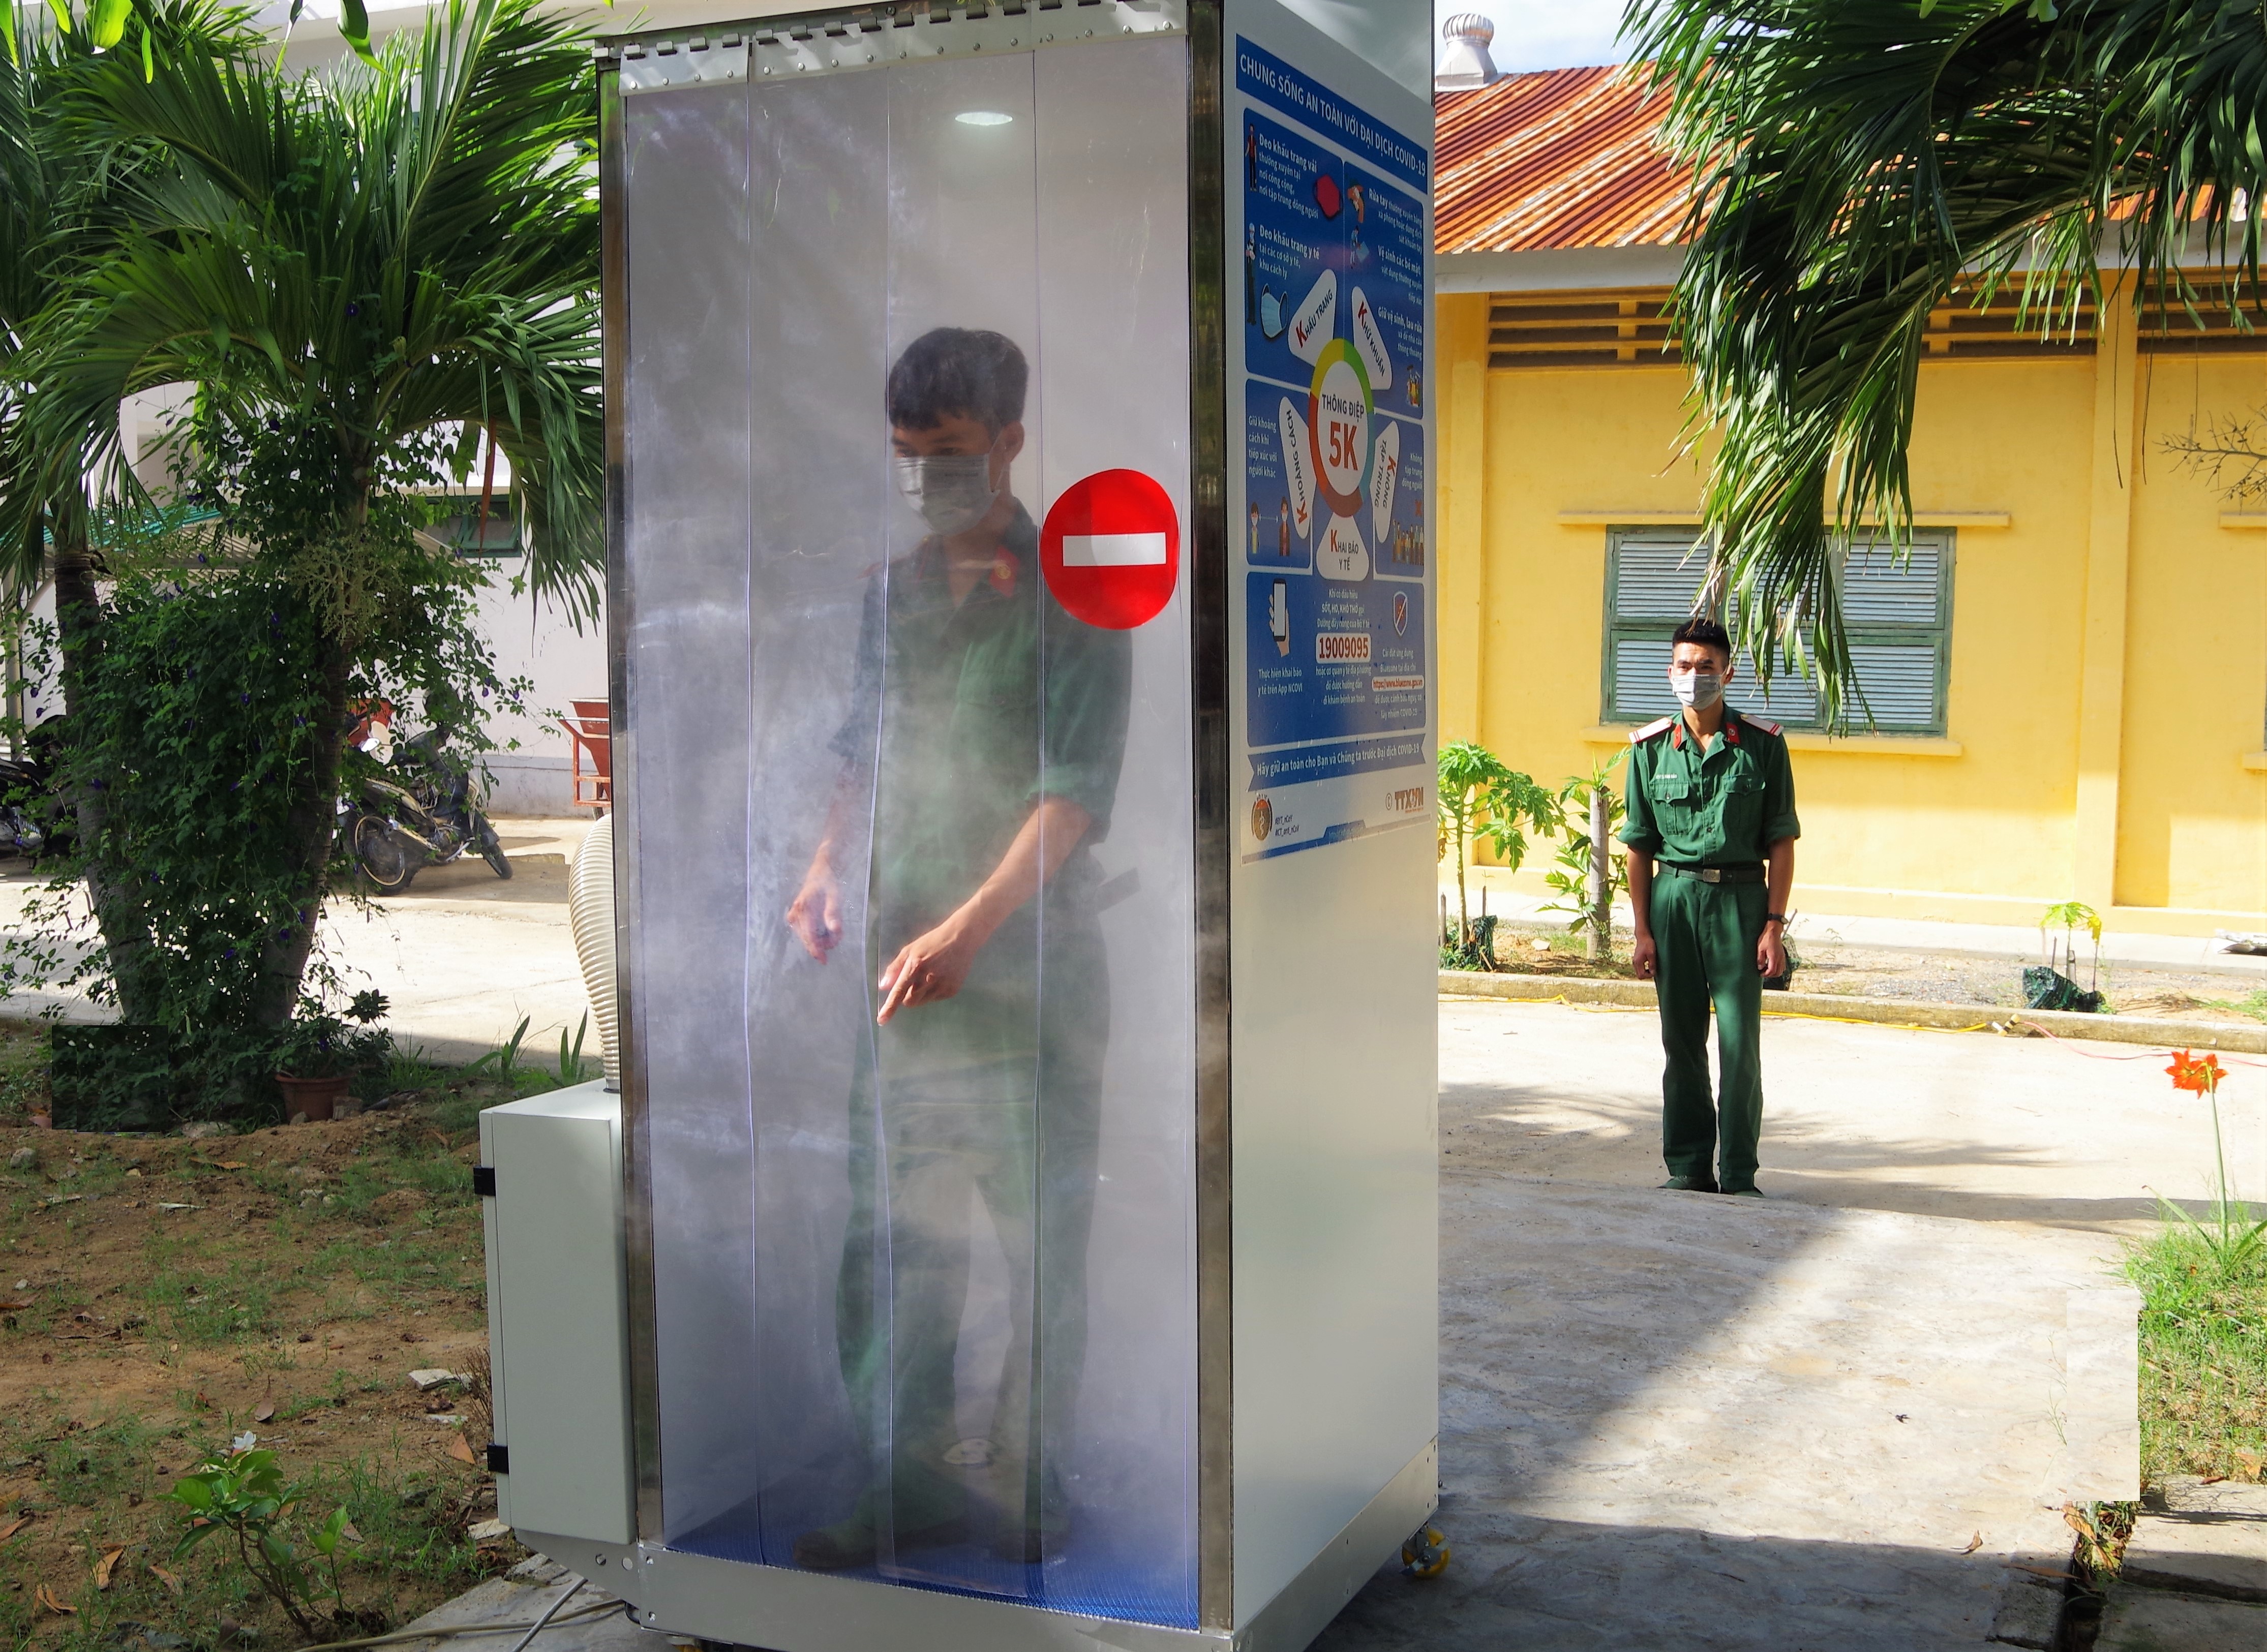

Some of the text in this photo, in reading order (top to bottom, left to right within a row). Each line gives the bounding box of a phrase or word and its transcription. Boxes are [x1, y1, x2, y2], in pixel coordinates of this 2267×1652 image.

[1322, 393, 1365, 422] THÔNG ĐIỆP
[1329, 421, 1358, 471] 5K
[1339, 557, 1350, 571] Y TẾ
[1319, 637, 1368, 659] 19009095
[1257, 743, 1419, 778] Hãy giữ an toàn cho Bạn và Chúng ta trước Đại dịch COVID-19
